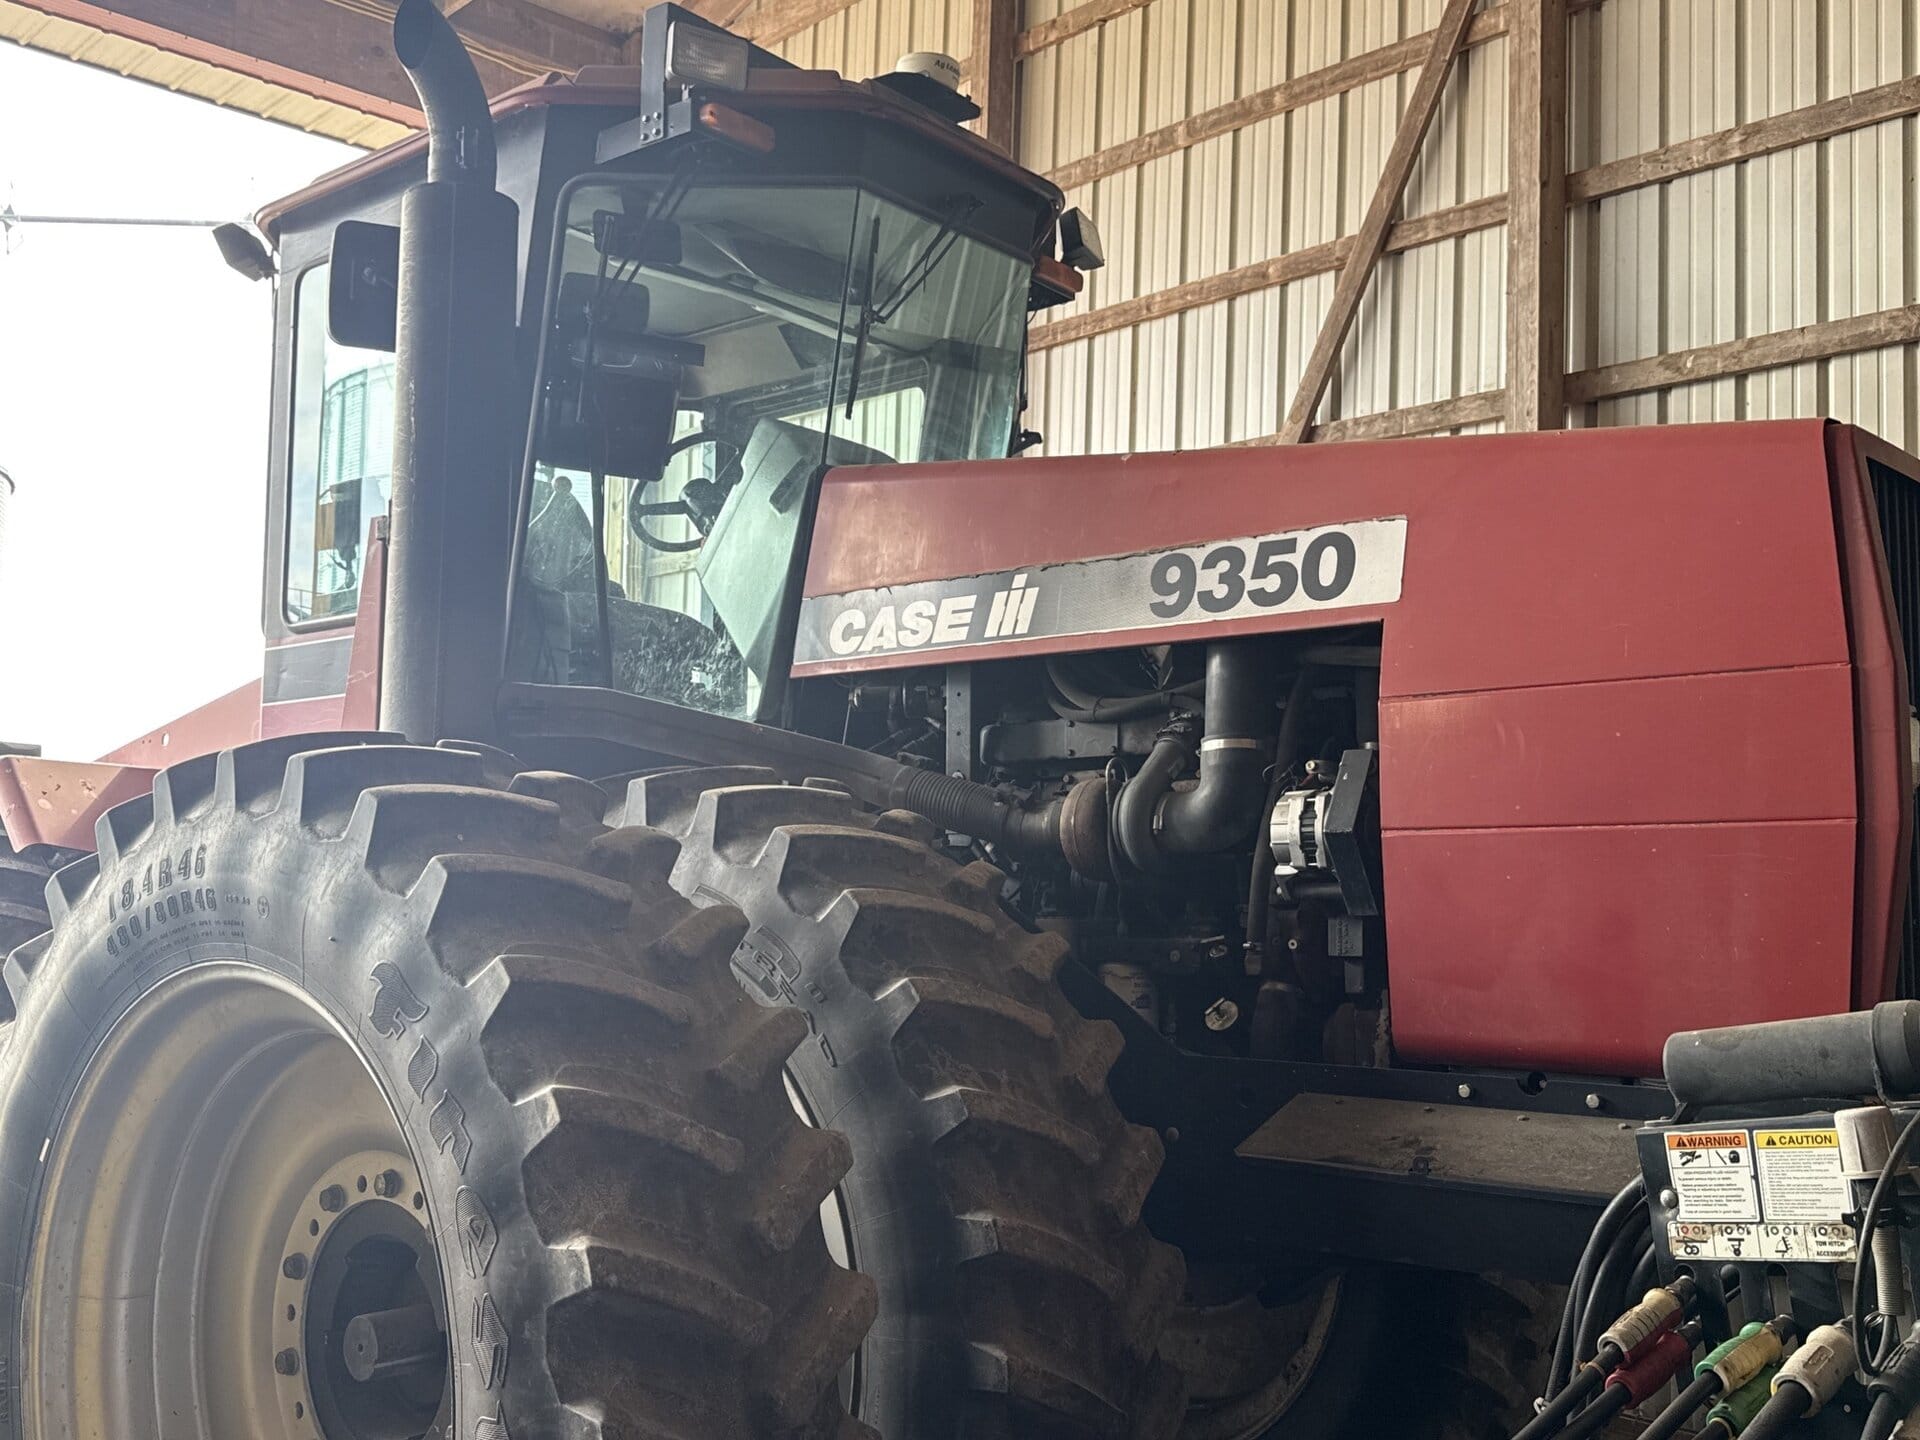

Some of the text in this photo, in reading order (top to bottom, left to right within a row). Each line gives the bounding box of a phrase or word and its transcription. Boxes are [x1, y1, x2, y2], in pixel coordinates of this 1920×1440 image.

[1151, 531, 1356, 618] 9350
[829, 594, 976, 654] CASE
[107, 888, 216, 956] 480/80R46
[1687, 1136, 1742, 1147] WARNING
[1779, 1134, 1832, 1145] CAUTION
